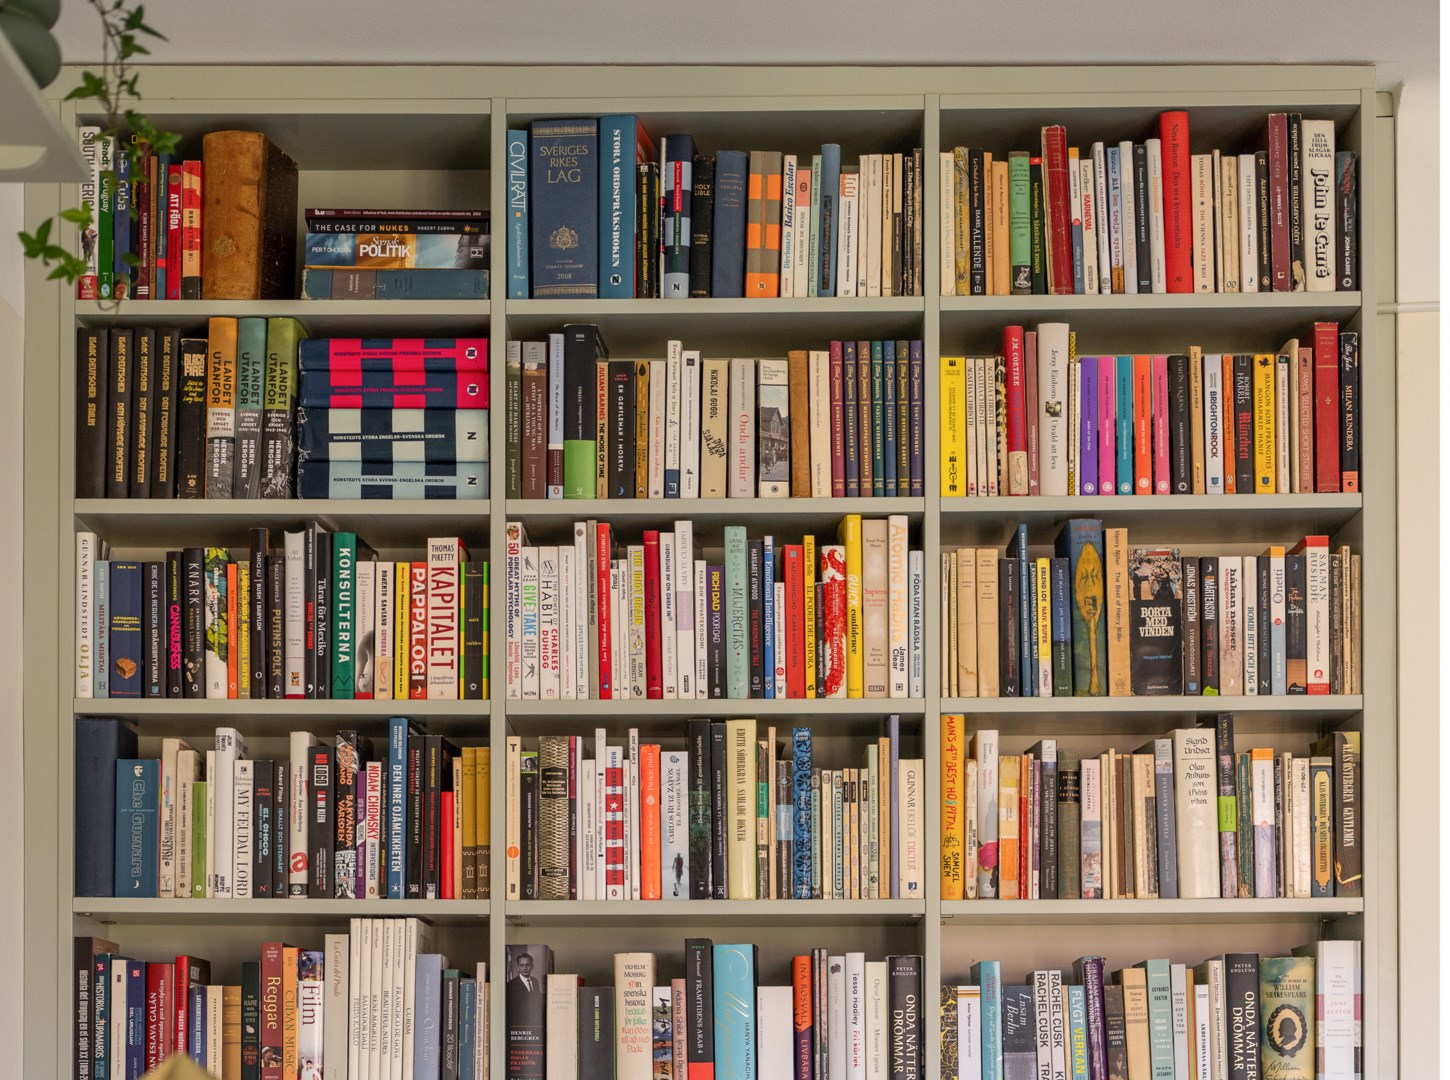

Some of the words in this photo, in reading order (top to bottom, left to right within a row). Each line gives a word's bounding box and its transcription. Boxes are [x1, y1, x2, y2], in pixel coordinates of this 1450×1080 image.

[102, 142, 110, 165] Bradt
[539, 146, 588, 156] SVERIGES
[549, 157, 578, 167] RIKES
[613, 129, 621, 164] STORA
[510, 142, 526, 213] CIVILRÄTT
[547, 169, 581, 184] LAG
[785, 162, 794, 196] Escolar
[1199, 179, 1207, 198] BÖHM
[1311, 169, 1330, 209] John
[170, 194, 179, 207] ATT
[612, 167, 622, 267] ORDSPRÅKSBOKEN
[785, 198, 793, 228] Básico
[1084, 194, 1092, 231] KARNEVAL
[170, 210, 181, 230] FÖDA
[1315, 213, 1330, 229] le
[359, 244, 411, 258] POLITIK
[973, 228, 982, 269] ALLENDE
[1316, 232, 1331, 278] Carré
[1049, 349, 1059, 366] Jerzy
[212, 351, 222, 404] UTANFÖR
[223, 361, 232, 405] LANDET
[240, 352, 250, 404] UTANFÖR
[251, 361, 260, 405] LANDET
[1050, 369, 1059, 399] Einhorn
[738, 414, 749, 443] Onda
[1050, 420, 1059, 442] Utvald
[1210, 391, 1218, 458] BRIGHTONROCK
[212, 439, 220, 477] BERGGREN
[739, 448, 750, 482] andar
[1050, 444, 1058, 454] att
[1050, 456, 1059, 469] leva
[188, 563, 200, 604] KNARK
[318, 579, 327, 603] Tårar
[508, 543, 519, 555] 50
[514, 608, 519, 617] OF
[523, 585, 536, 607] GIVE
[765, 561, 773, 600] Emotional
[848, 574, 859, 607] QUICK
[1229, 568, 1238, 608] håkan
[318, 604, 327, 619] för
[339, 548, 350, 663] KONSULTERNA
[431, 567, 454, 670] KAPITALET
[541, 580, 552, 625] HABIT
[732, 588, 743, 650] MUJERCITAS
[1247, 607, 1255, 631] BOMBI
[272, 609, 281, 647] PUTINS
[318, 621, 326, 656] Mexiko
[412, 568, 425, 680] PAPPALOGI
[524, 613, 536, 636] TAKE
[765, 603, 773, 647] Intelligence
[850, 609, 859, 654] confidence
[1230, 610, 1238, 651] nesser
[79, 644, 90, 679] OLJA
[273, 650, 281, 676] FOLK
[892, 649, 900, 670] Clear
[1247, 670, 1255, 683] JAG
[947, 716, 957, 742] MAN'S
[1343, 744, 1353, 761] KLAS
[368, 766, 379, 792] NOAM
[392, 765, 402, 781] DEN
[907, 770, 916, 808] GUNNAR
[946, 761, 957, 785] BEST
[1343, 763, 1355, 802] ÖSTERGREN
[132, 780, 145, 808] Che
[238, 789, 250, 808] MY
[392, 784, 402, 803] INRE
[946, 787, 957, 831] HOSPITAL
[368, 796, 380, 839] CHOMSKY
[907, 809, 916, 838] EKELÖF
[1343, 808, 1354, 847] GENTLEMEN
[132, 813, 145, 877] Guevara
[236, 812, 249, 858] FEUDAL
[392, 806, 404, 872] OJÄMLIKHETEN
[907, 841, 916, 870] DIKTER
[944, 855, 952, 877] SHEM
[951, 851, 959, 882] SAMUEL
[236, 862, 249, 896] LORD
[264, 977, 281, 1029] Reggae
[285, 990, 294, 1031] CUBAN
[303, 984, 321, 1026] Film
[906, 995, 916, 1029] ONDA
[1019, 993, 1031, 1025] Ensam
[1050, 974, 1061, 1016] RACHEL
[1072, 991, 1083, 1024] FLYGT
[1007, 1005, 1019, 1035] Berlin
[1053, 1019, 1063, 1048] CUSK
[285, 1036, 294, 1074] MUSIC
[893, 1010, 906, 1073] DRÖMMAR
[1074, 1027, 1085, 1074] VERKAN
